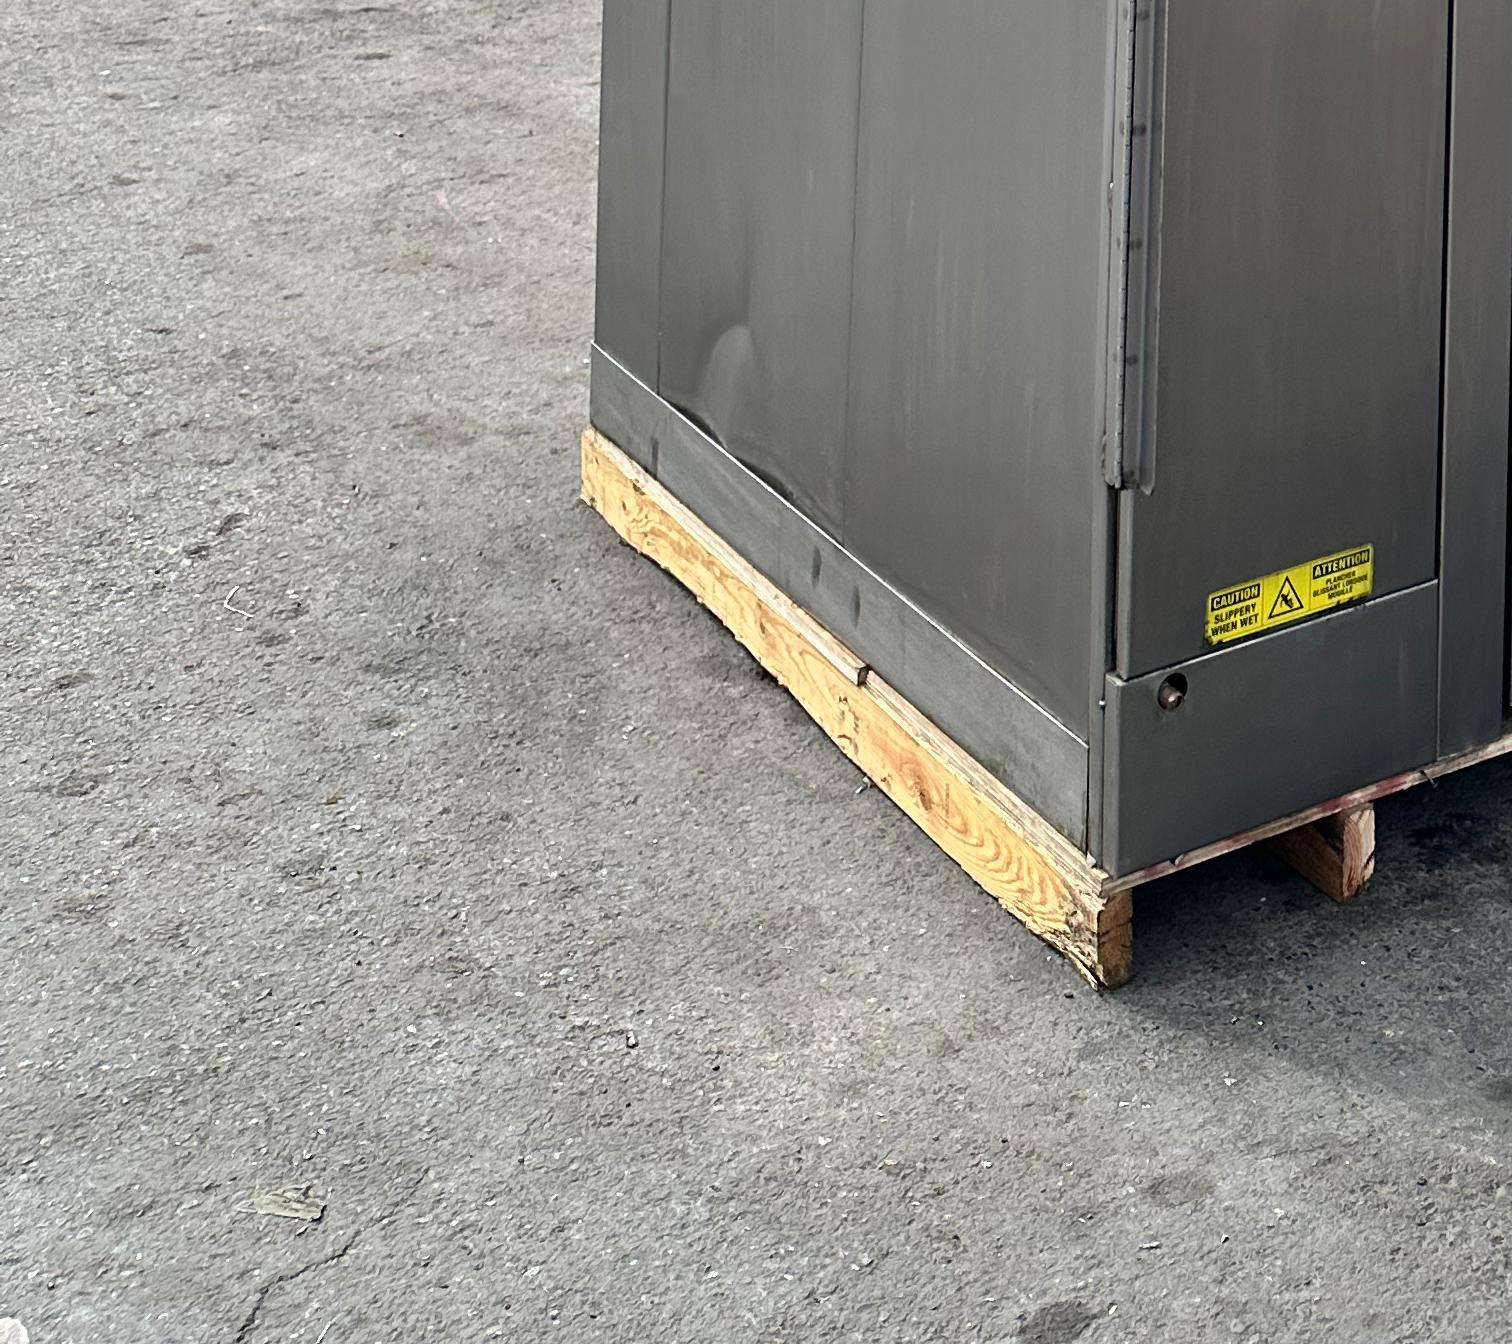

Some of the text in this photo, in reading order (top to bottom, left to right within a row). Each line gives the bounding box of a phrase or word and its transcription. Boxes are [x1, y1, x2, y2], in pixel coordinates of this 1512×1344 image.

[1314, 550, 1369, 577] ATTENTION
[1212, 585, 1259, 609] CAUTION
[1211, 613, 1260, 636] WHEN WET
[1214, 602, 1257, 624] SLIPPERY
